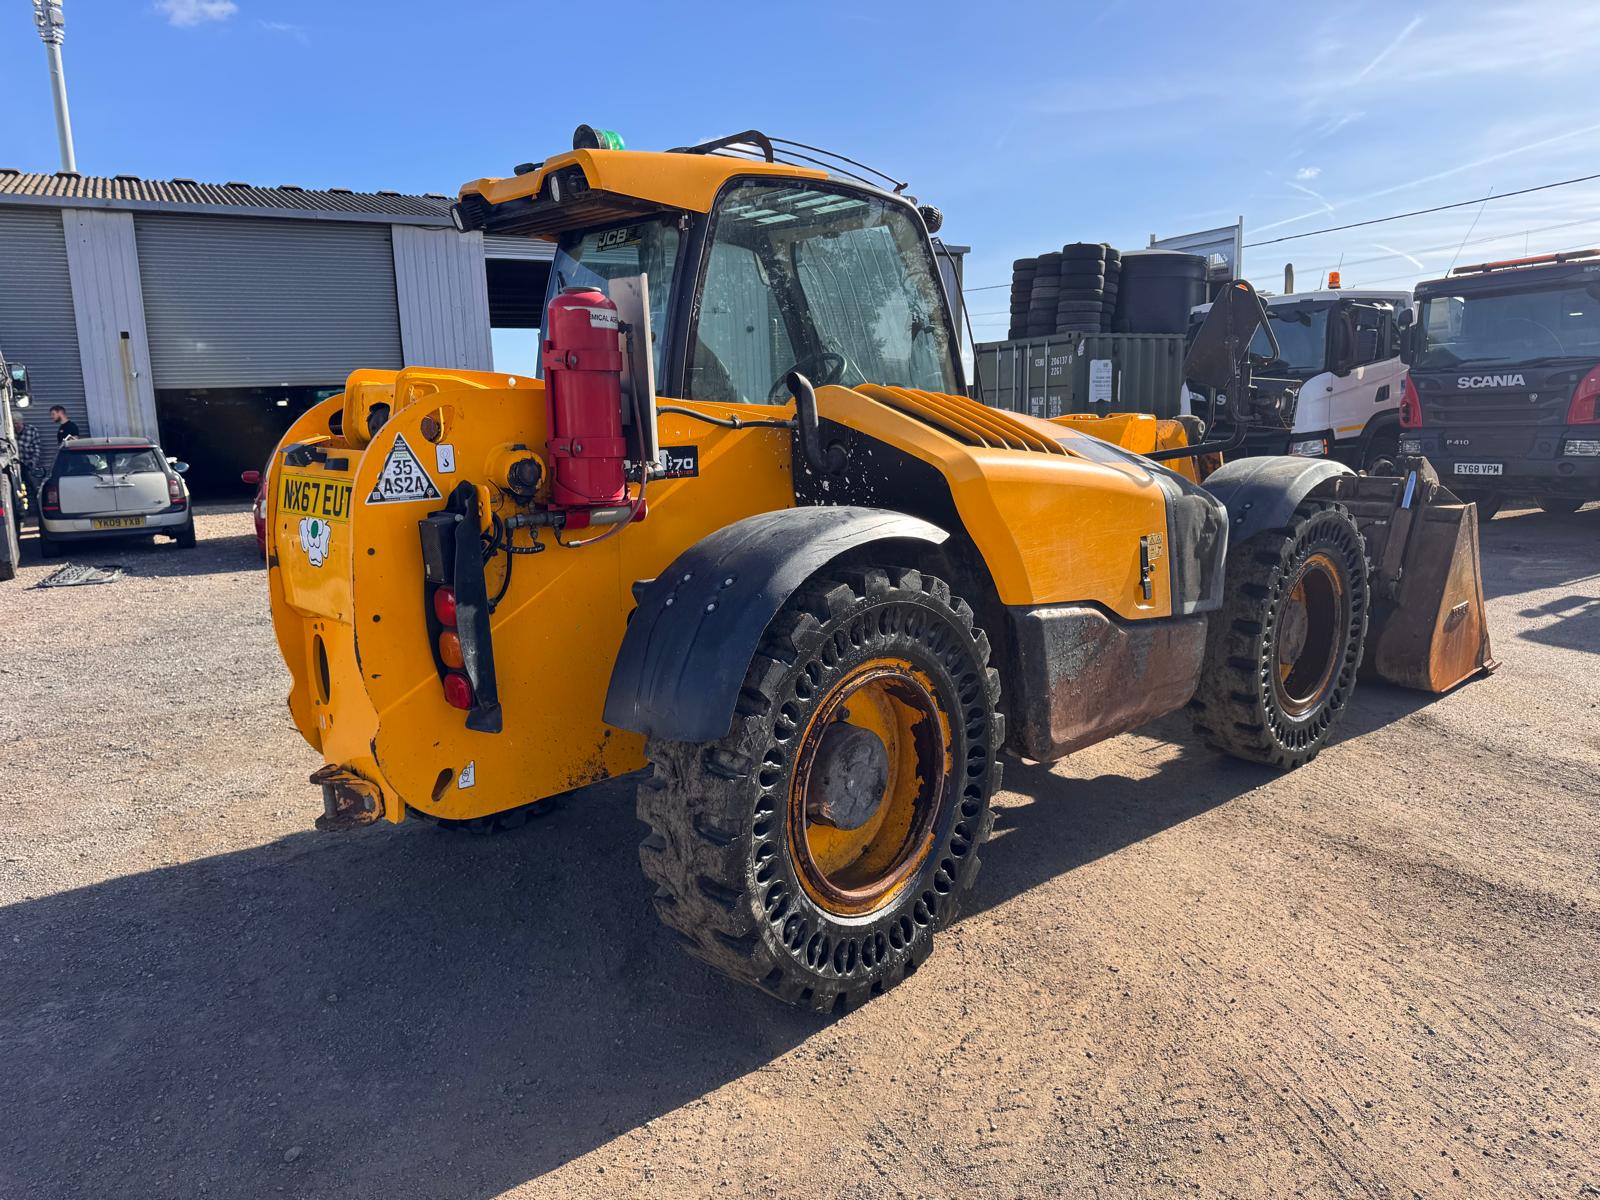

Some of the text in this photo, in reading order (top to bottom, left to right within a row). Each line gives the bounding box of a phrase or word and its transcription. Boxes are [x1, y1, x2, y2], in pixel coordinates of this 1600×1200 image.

[599, 229, 627, 246] JCB
[1457, 374, 1525, 388] SCANIA
[392, 459, 412, 476] 35
[1457, 464, 1500, 474] EY68 VPM
[384, 476, 424, 494] AS2A
[284, 479, 353, 518] NX67 EUT
[98, 518, 141, 527] YK09 YXB
